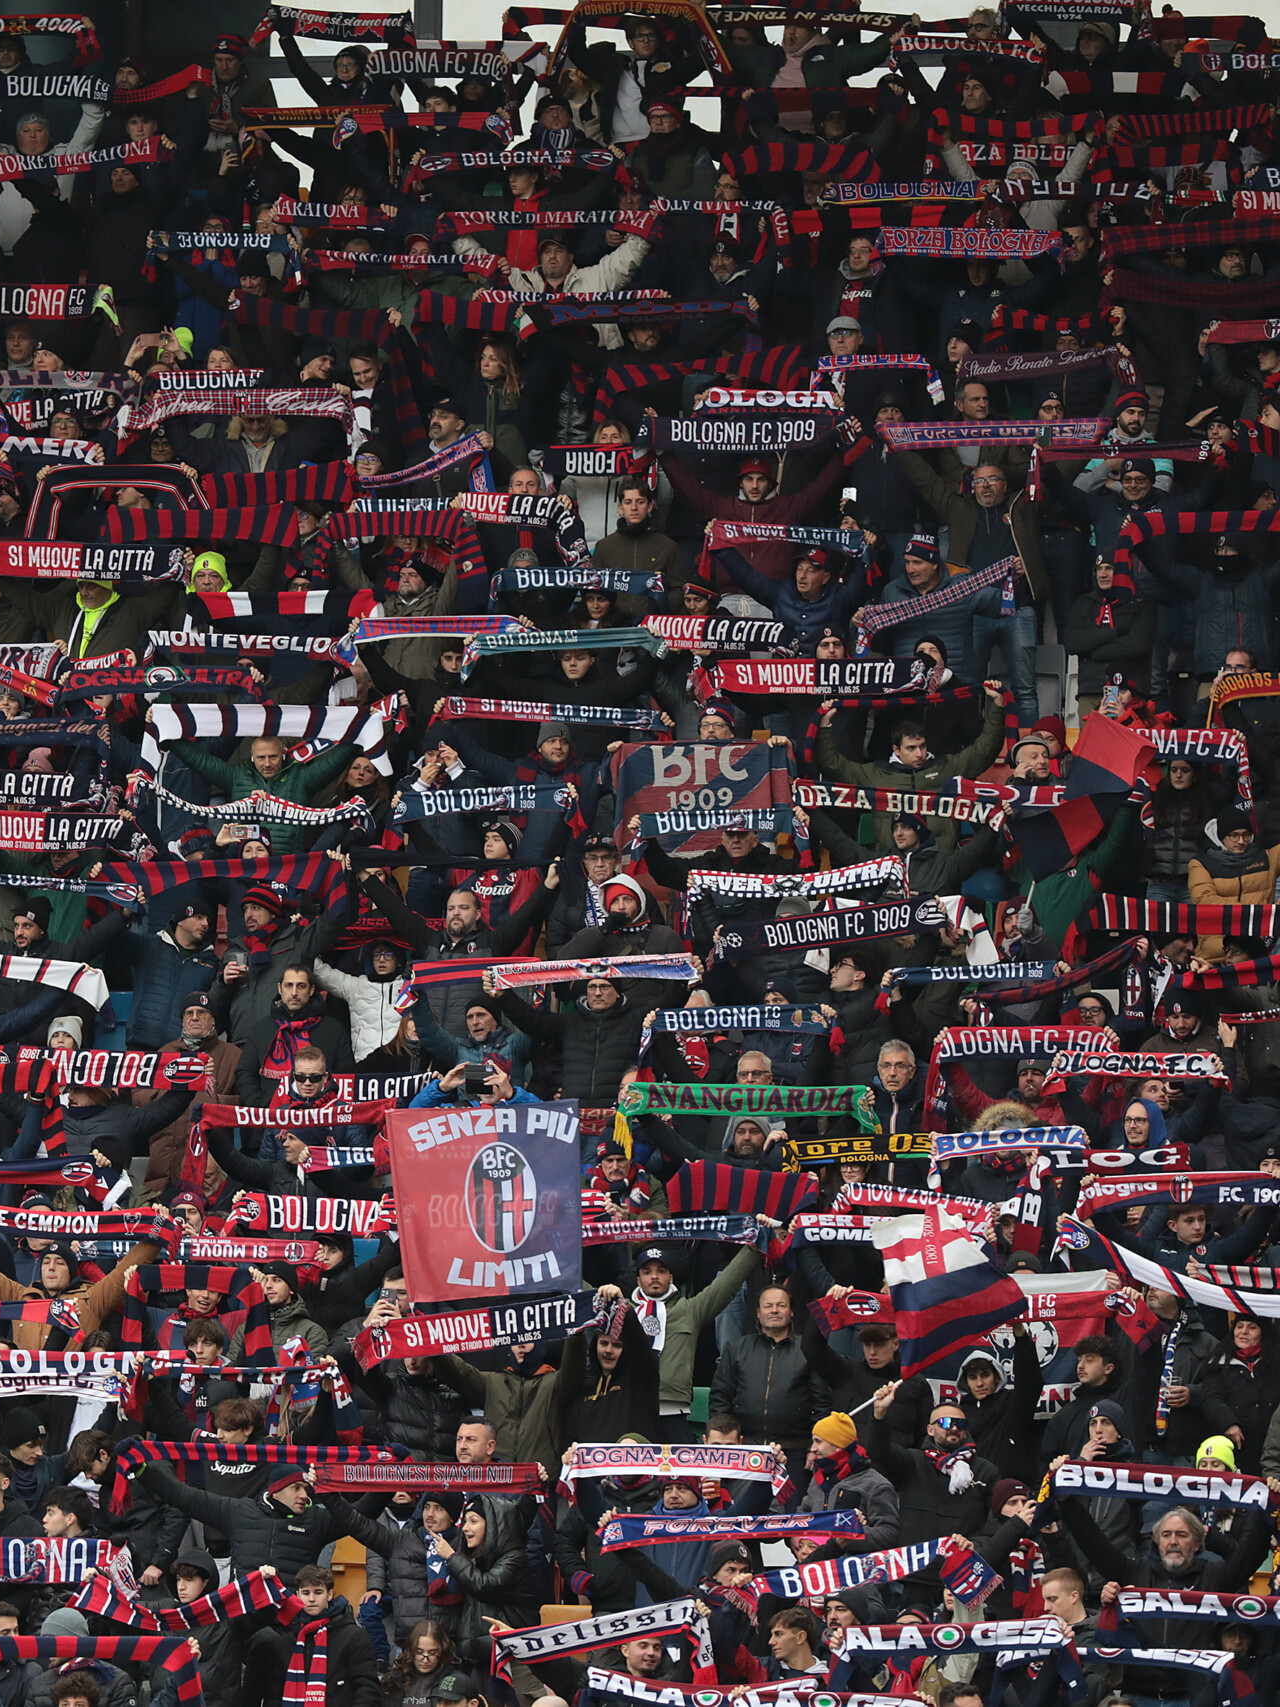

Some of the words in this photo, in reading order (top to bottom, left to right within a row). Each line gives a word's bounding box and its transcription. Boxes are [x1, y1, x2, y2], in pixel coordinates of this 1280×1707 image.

[1016, 4, 1071, 14] VECCHIA
[1074, 5, 1123, 15] GUARDIA
[64, 139, 151, 165] MARATONA
[840, 182, 976, 200] BOLOGNA
[458, 210, 522, 227] TORRE
[525, 212, 542, 223] DI
[544, 210, 646, 229] MARATONA
[884, 229, 946, 250] FORZA
[950, 230, 1049, 251] BOLOGNA
[68, 288, 86, 305] FC
[68, 305, 83, 316] 1909
[962, 357, 1002, 379] Stadio
[1004, 355, 1053, 374] Renato
[159, 370, 245, 390] BOLOGNA
[671, 419, 746, 444] BOLOGNA
[752, 420, 772, 443] FC
[777, 419, 815, 443] 1909
[8, 545, 24, 567] SI
[27, 546, 81, 570] MUOVE
[84, 548, 104, 570] LA
[107, 545, 154, 572] CITTÀ
[148, 629, 331, 654] MONTEVEGLIO
[648, 616, 704, 640] MUOVE
[707, 618, 727, 641] LA
[731, 618, 784, 643] CITTÀ
[736, 663, 754, 684] SI
[758, 663, 814, 685] MUOVE
[820, 663, 840, 684] LA
[846, 658, 895, 685] CITTÀ
[481, 699, 496, 713] SI
[501, 700, 550, 715] MUOVE
[556, 703, 575, 717] LA
[650, 745, 749, 788] BFC
[667, 788, 734, 811] 1909
[49, 818, 67, 840] LA
[471, 880, 516, 896] Saputo
[765, 914, 839, 948] BOLOGNA
[844, 911, 865, 935] FC
[872, 903, 910, 932] 1909
[664, 1006, 760, 1032] BOLOGNA
[765, 1005, 781, 1019] FC
[765, 1019, 780, 1028] 1909
[645, 1083, 855, 1114] AVANGUARDIA
[407, 1107, 517, 1152] SENZA
[525, 1106, 579, 1144] PIÙ
[937, 1125, 1085, 1155] BOLOGNA
[481, 1146, 516, 1170] BFC
[840, 1154, 890, 1164] BOLOGNA
[488, 1169, 512, 1179] 1909
[14, 1212, 99, 1235] CEMPION
[269, 1195, 381, 1233] BOLOGNA
[800, 1214, 855, 1227] PER
[446, 1250, 562, 1289] LIMITI
[404, 1323, 424, 1348] SI
[427, 1312, 490, 1342] MUOVE
[495, 1308, 517, 1336] LA
[523, 1296, 577, 1332] CITTÀ
[210, 1461, 255, 1474] Saputo
[344, 1464, 430, 1483] BOLOGNESI
[434, 1464, 483, 1482] SIAMO
[486, 1466, 513, 1483] NOI
[1055, 1463, 1270, 1511] BOLOGNA
[1119, 1592, 1228, 1617] SALA
[587, 1666, 686, 1706] SALA
